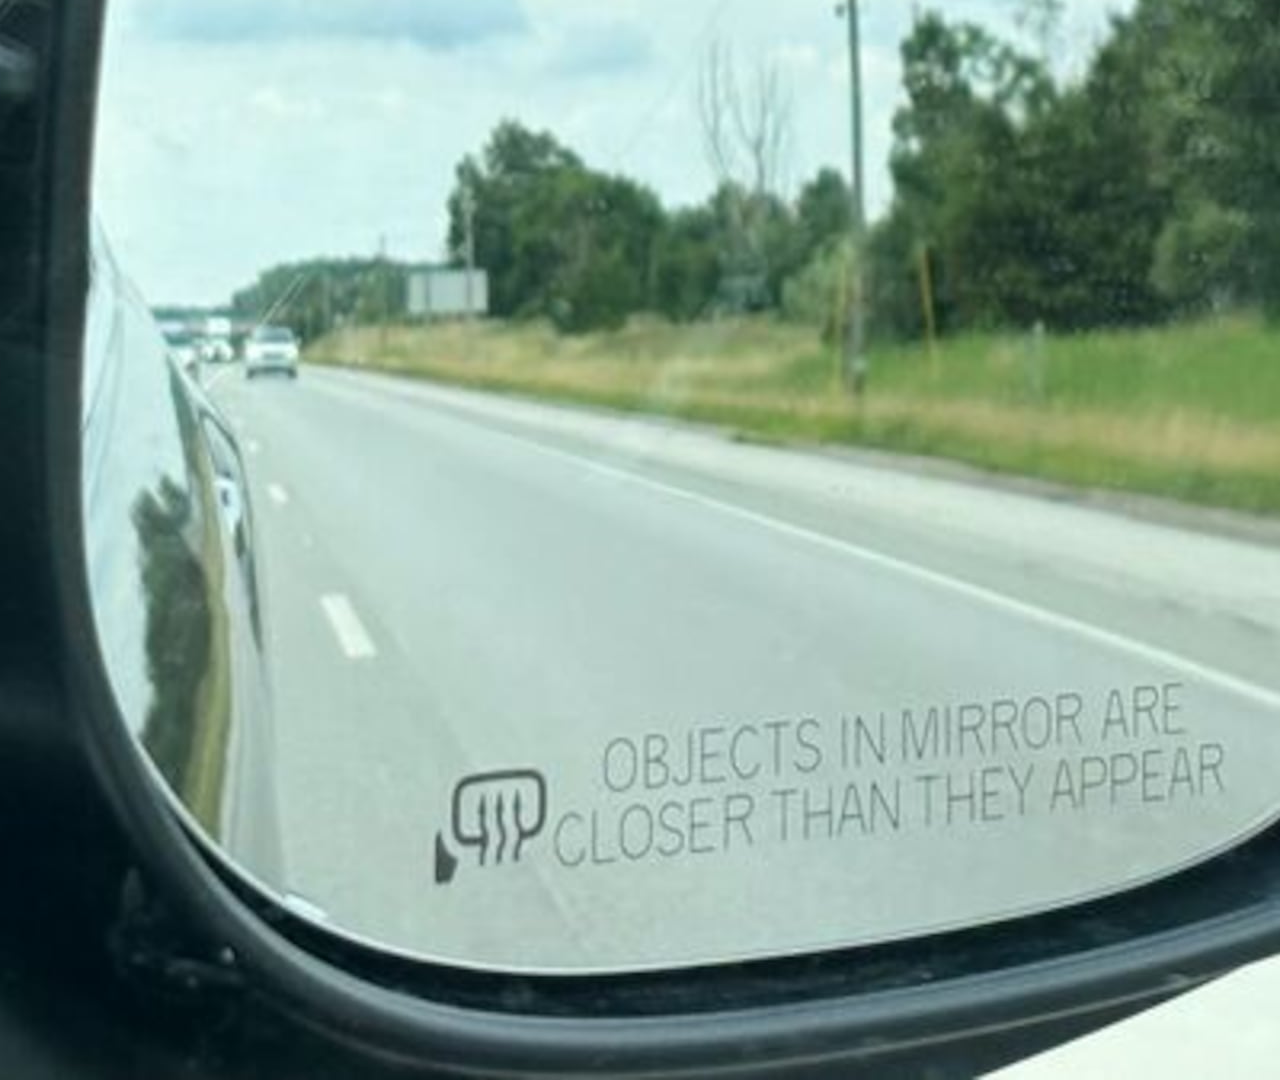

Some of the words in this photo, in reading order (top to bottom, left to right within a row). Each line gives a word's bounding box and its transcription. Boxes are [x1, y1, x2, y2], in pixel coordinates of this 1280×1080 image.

[603, 718, 822, 792] OBJECTS
[838, 712, 886, 768] IN
[901, 691, 1082, 761] MIRROR
[1100, 682, 1186, 741] ARE
[554, 793, 754, 867] CLOSER
[768, 778, 902, 841] THAN
[916, 762, 1035, 827] THEY
[1049, 743, 1224, 811] APPEAR
